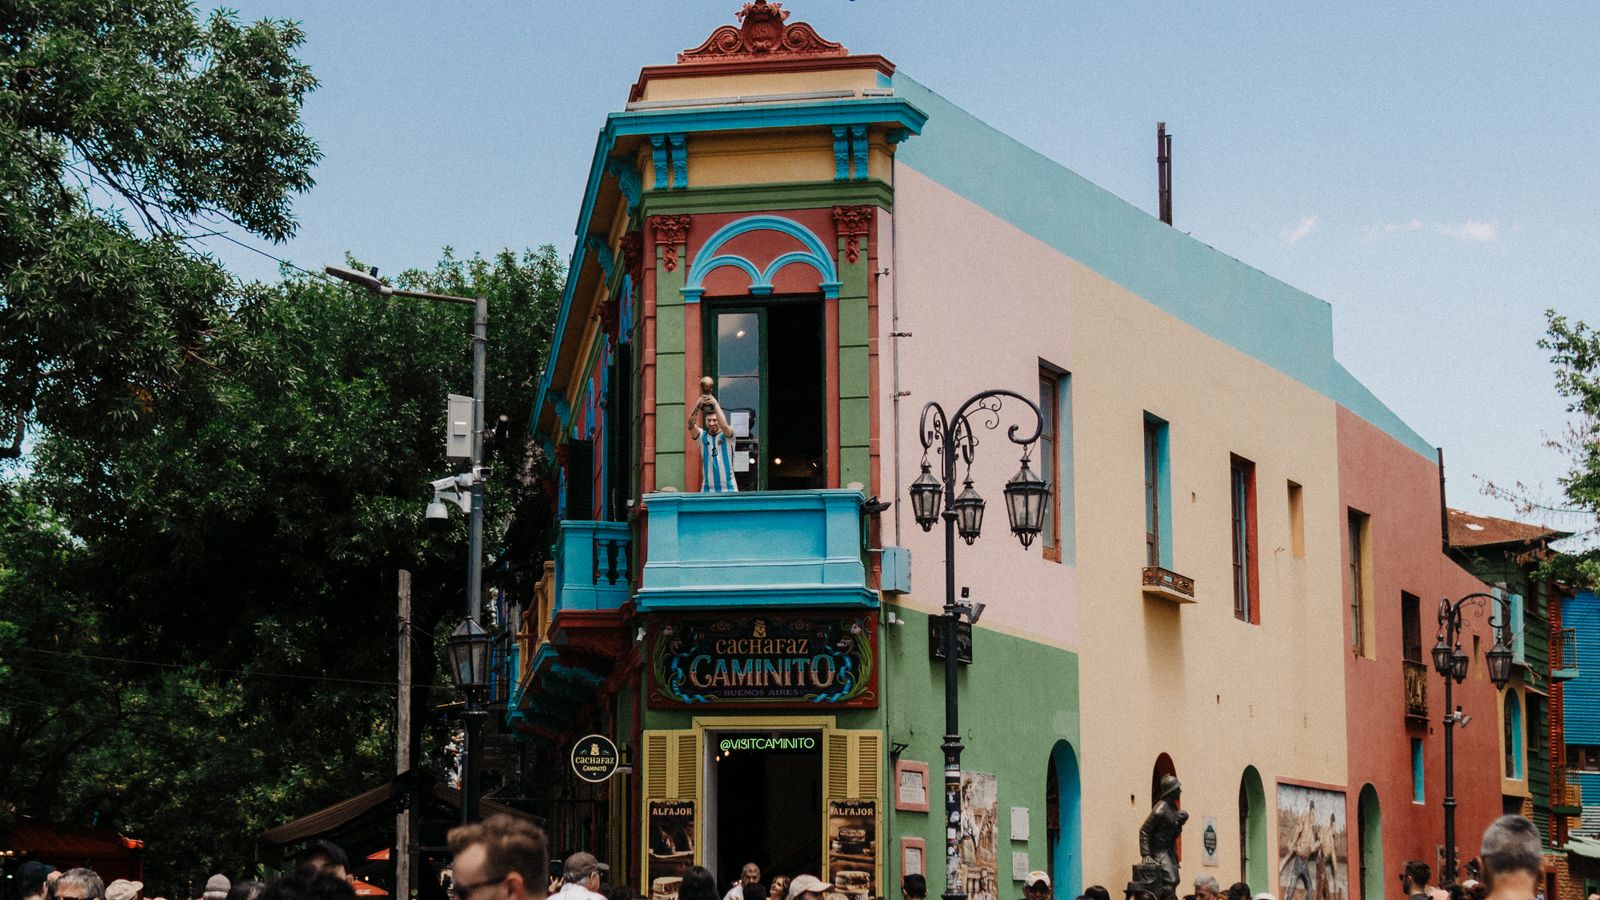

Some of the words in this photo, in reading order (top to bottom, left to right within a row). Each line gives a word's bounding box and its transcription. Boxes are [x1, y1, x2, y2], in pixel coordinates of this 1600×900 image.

[690, 653, 836, 688] CAMINITO
[723, 689, 765, 697] BUENOS
[768, 689, 800, 697] AIRES
[719, 737, 815, 751] @VISITCAMINITO
[652, 807, 693, 816] ALFAJOR
[832, 807, 874, 816] ALFAJOR
